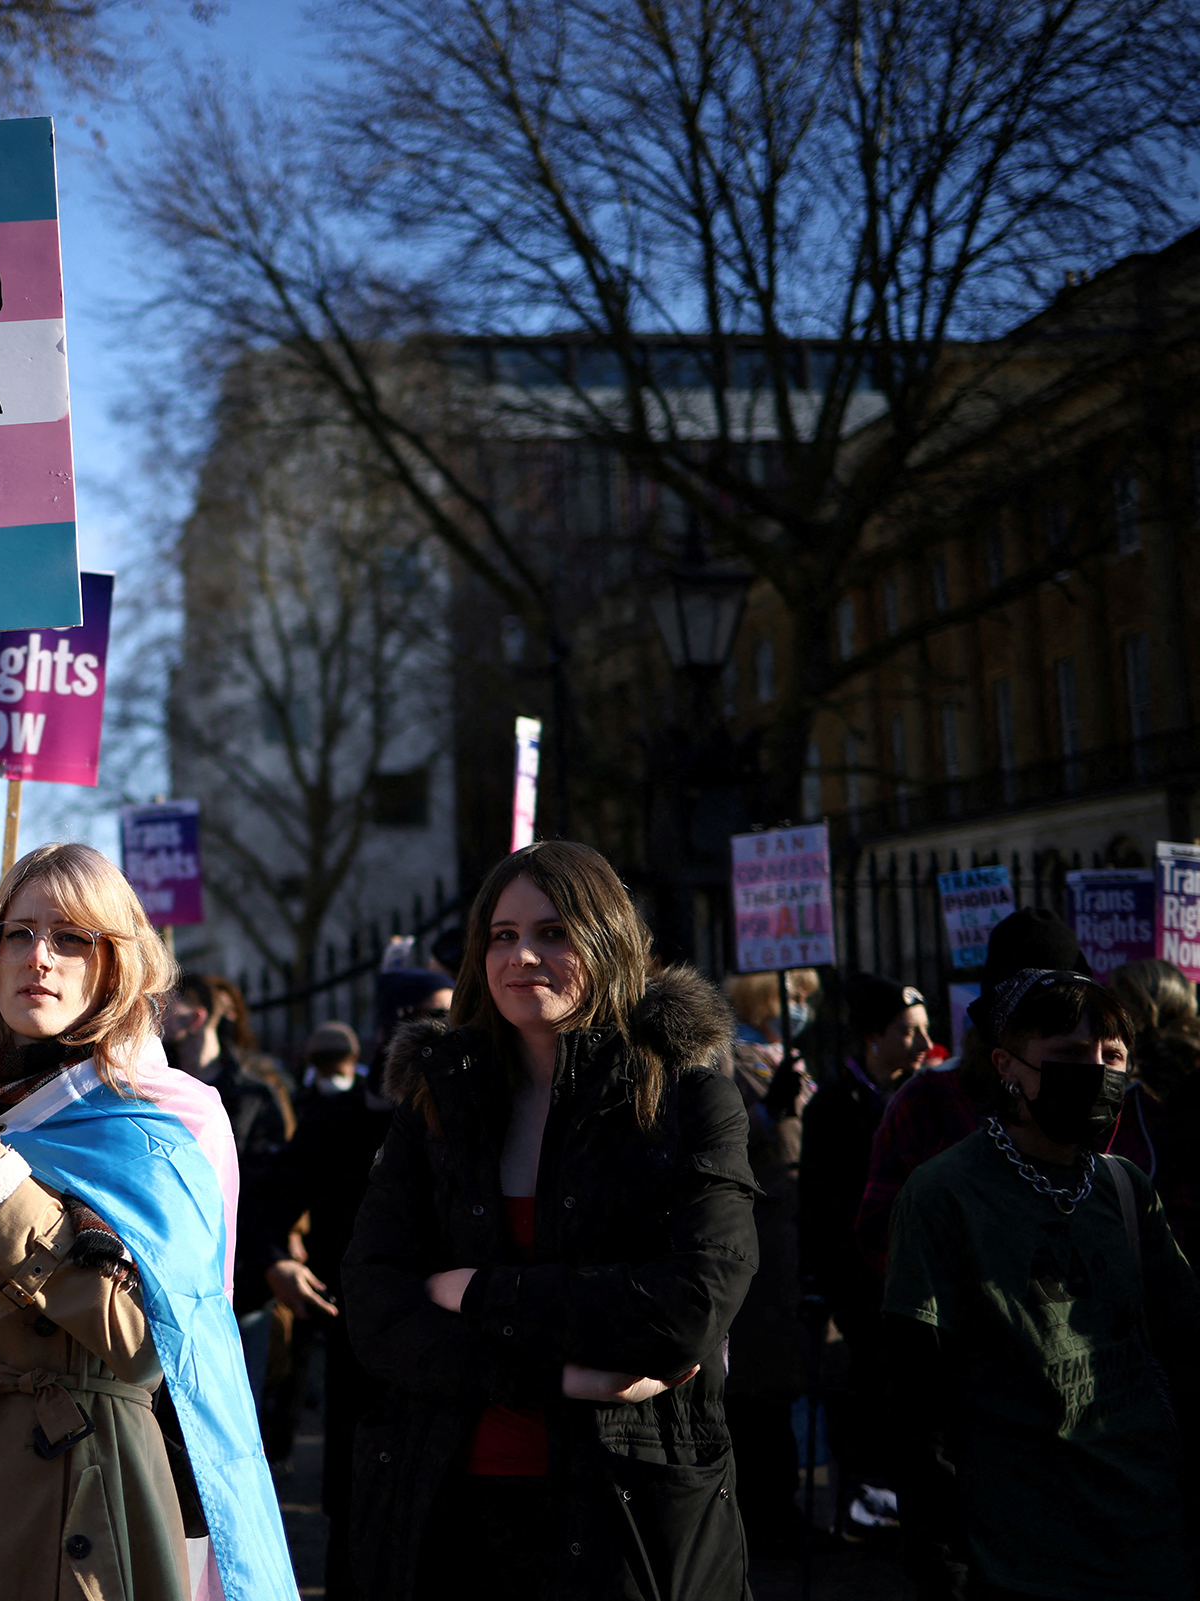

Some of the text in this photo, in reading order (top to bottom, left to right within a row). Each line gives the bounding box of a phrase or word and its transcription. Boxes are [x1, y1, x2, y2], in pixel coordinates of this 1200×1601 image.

[756, 834, 805, 857] BAN
[742, 883, 822, 906] THERAPY
[946, 889, 1010, 912] PHOBIA
[1070, 884, 1135, 912] Trans
[776, 903, 829, 939] ALL
[960, 909, 979, 927] IS
[1076, 912, 1152, 950] Rights
[1048, 1341, 1139, 1388] REMEMBER
